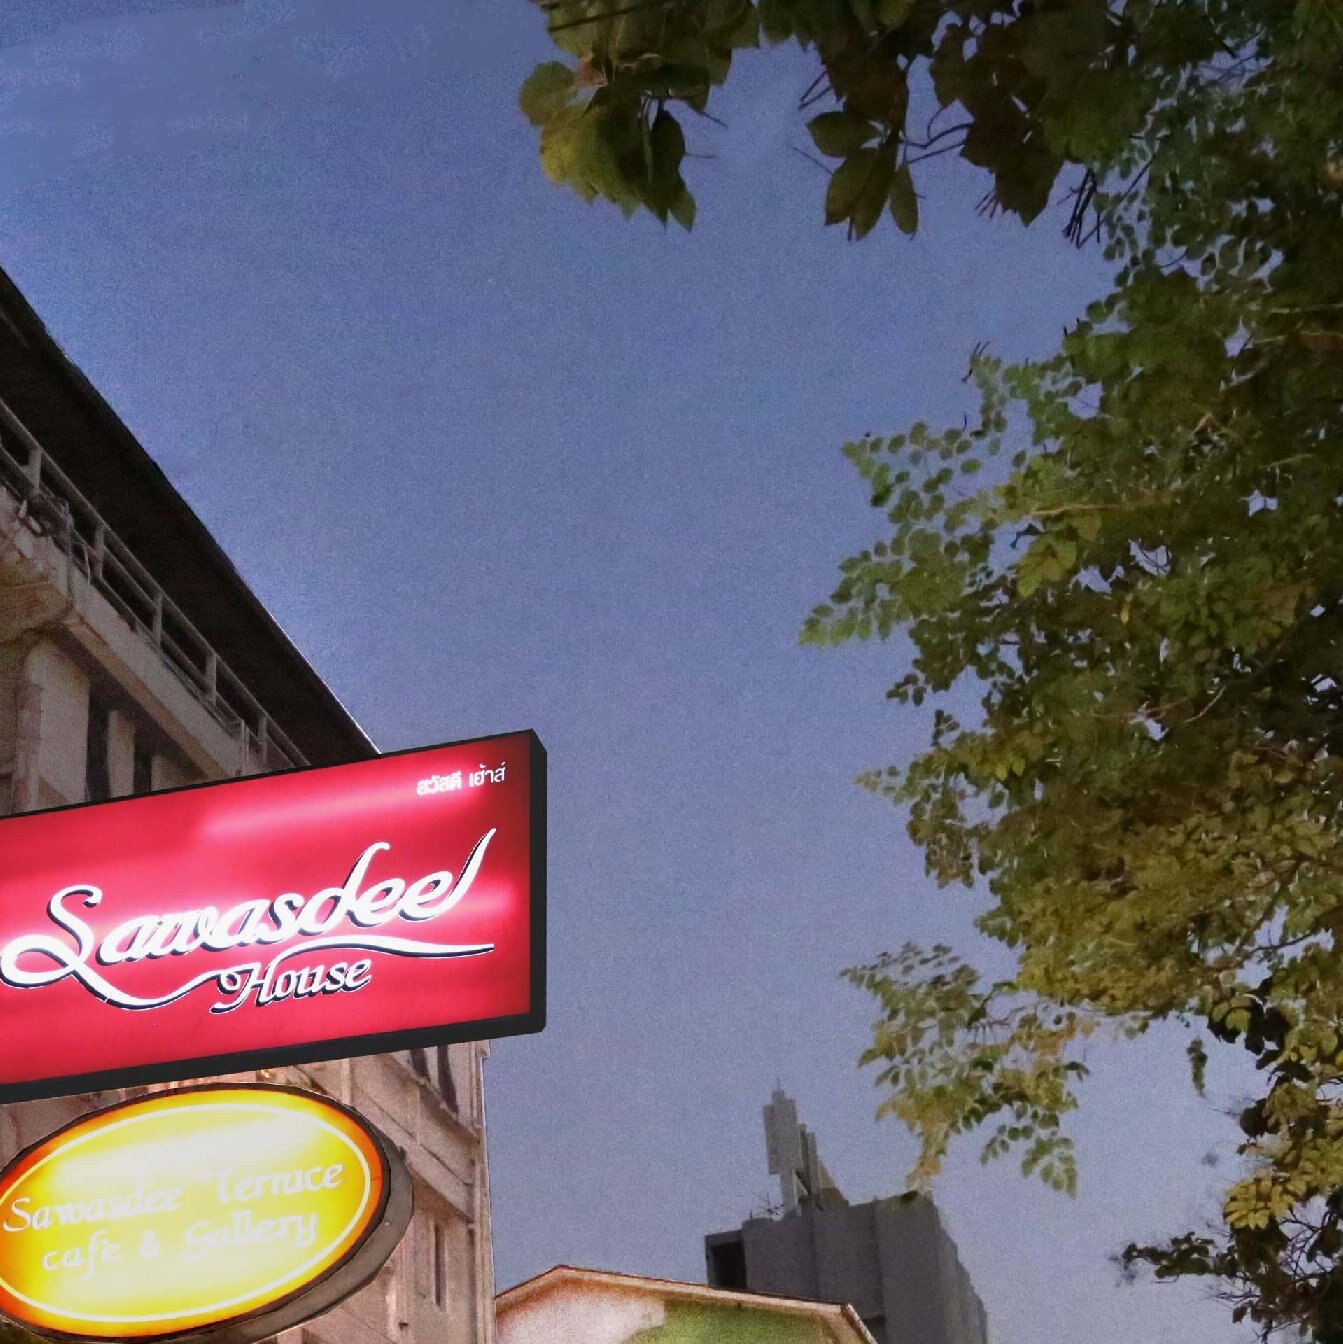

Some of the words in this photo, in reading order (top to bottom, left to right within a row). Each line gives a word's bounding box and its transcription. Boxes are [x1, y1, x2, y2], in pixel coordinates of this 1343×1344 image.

[209, 957, 373, 1014] House
[2, 1176, 184, 1233] Sawasdee
[199, 1162, 345, 1206] Terrace
[180, 1208, 319, 1264] Gallery
